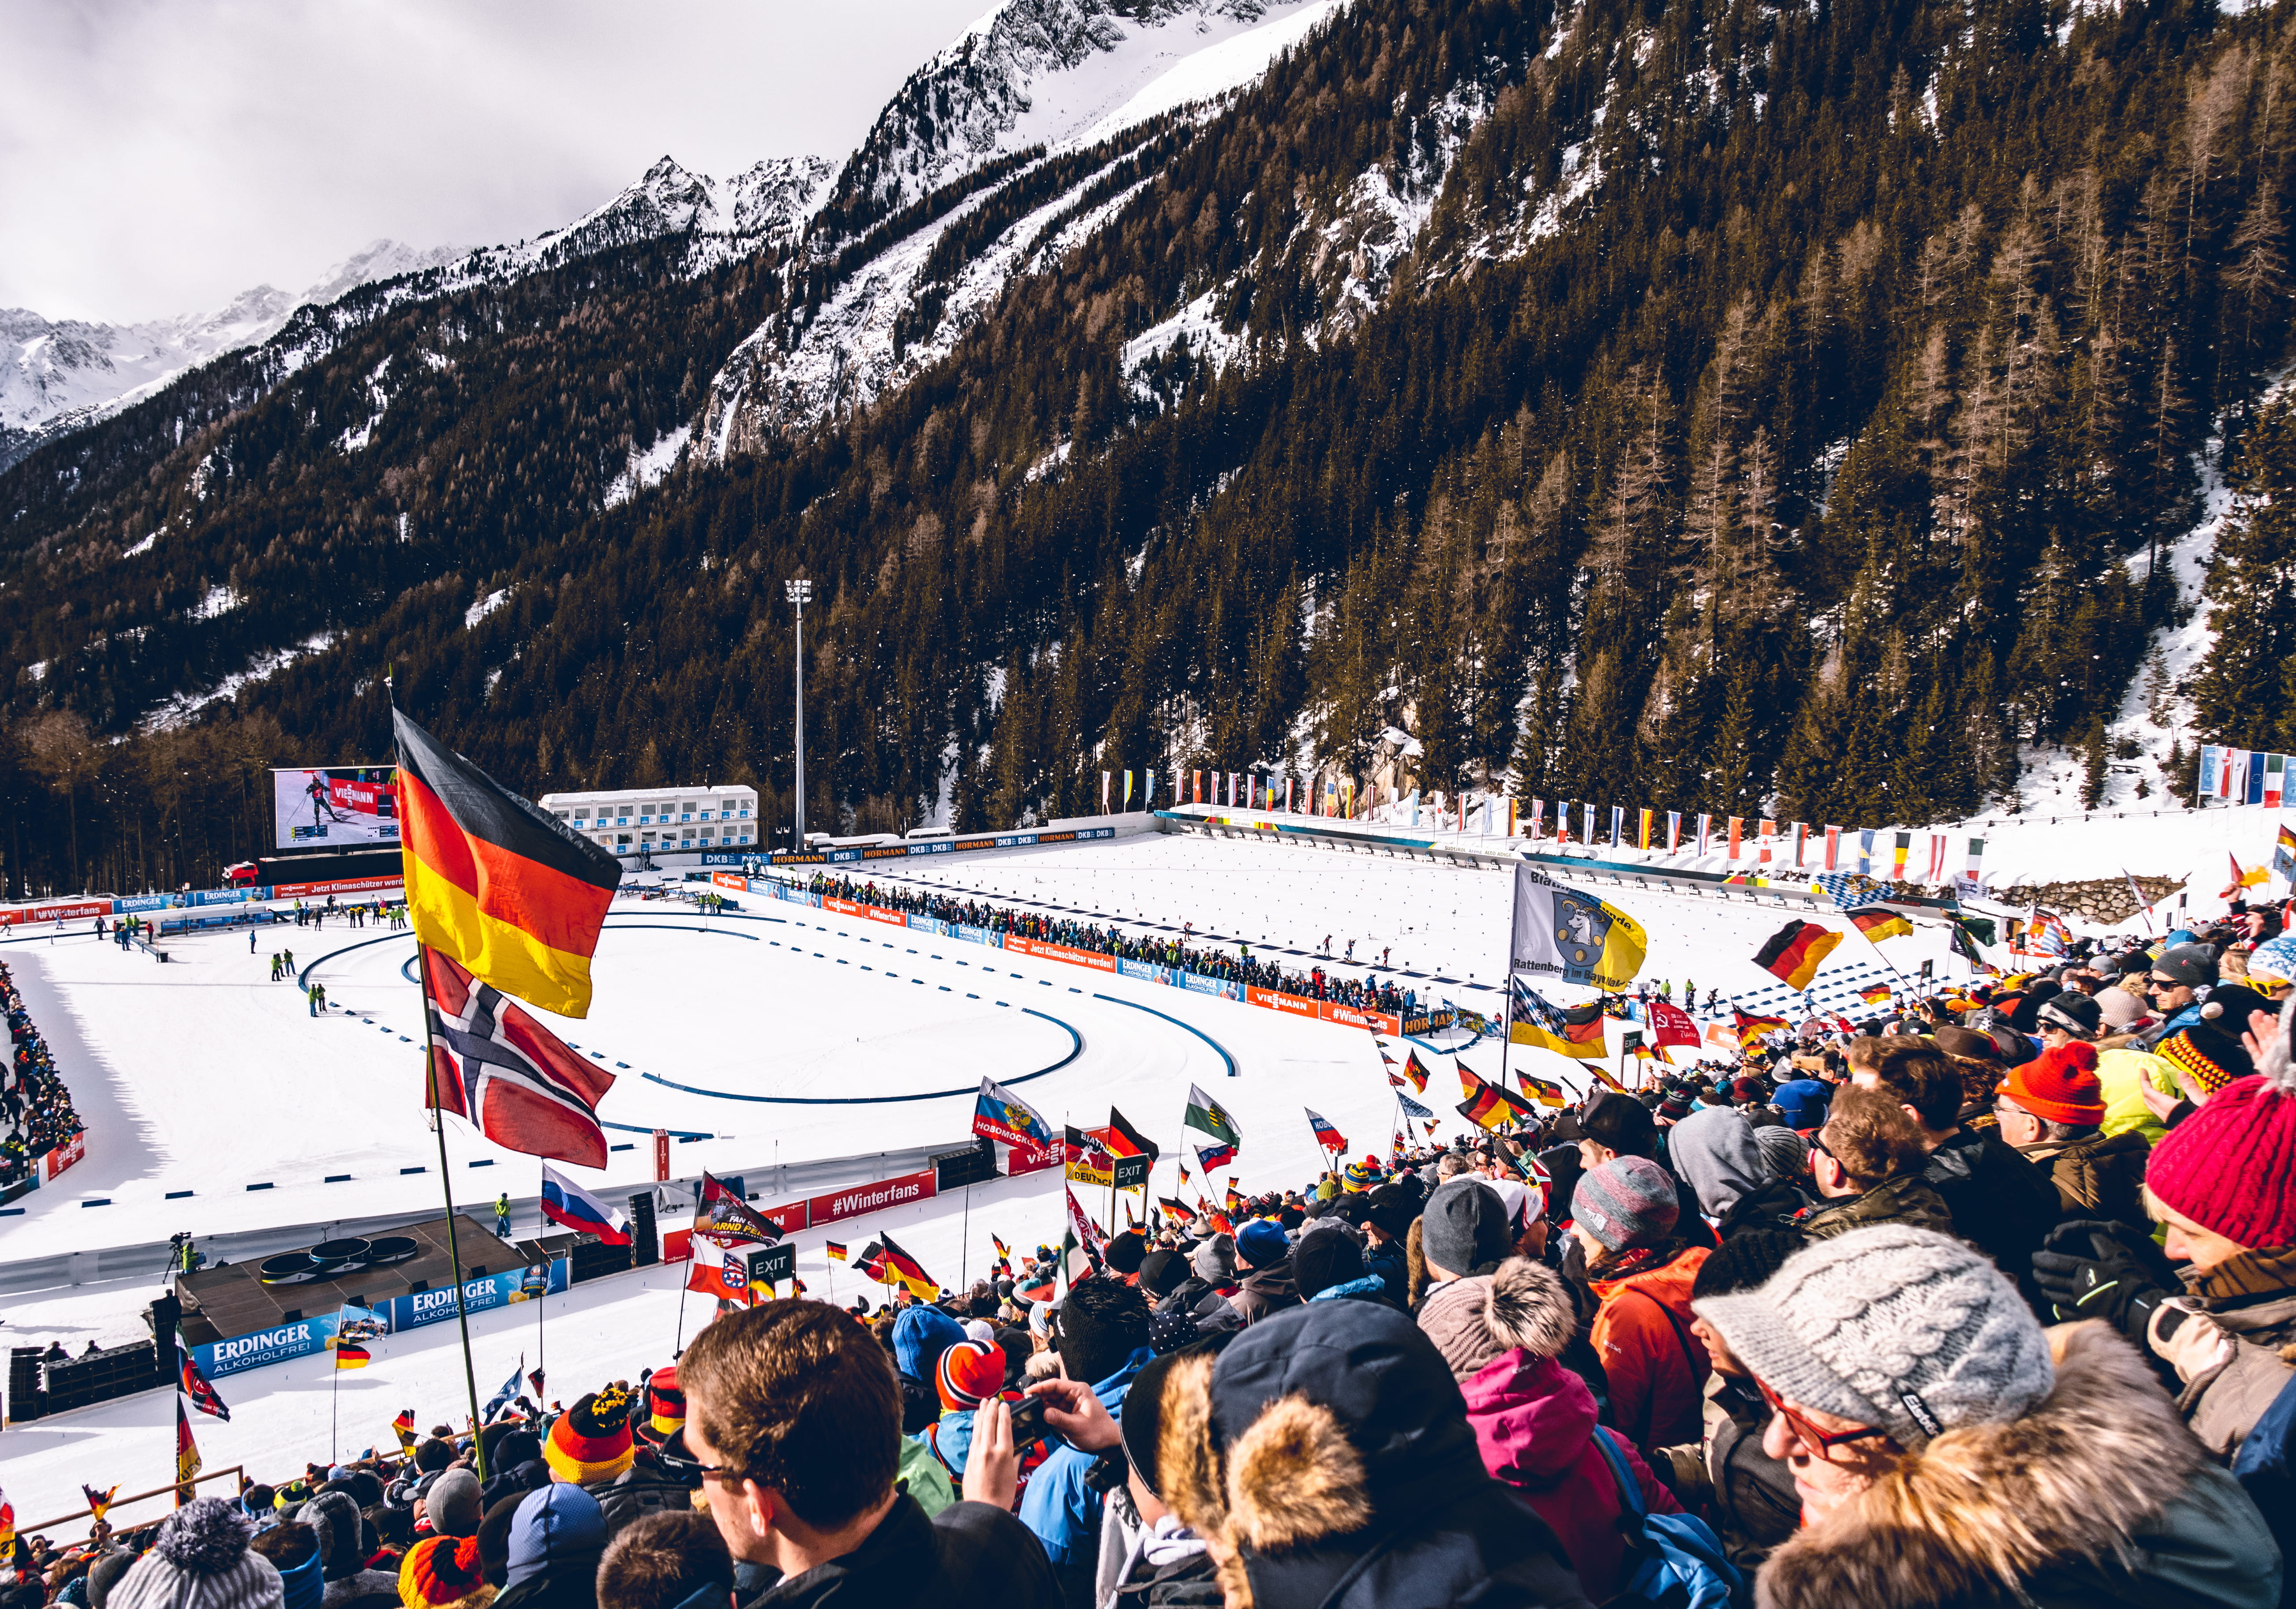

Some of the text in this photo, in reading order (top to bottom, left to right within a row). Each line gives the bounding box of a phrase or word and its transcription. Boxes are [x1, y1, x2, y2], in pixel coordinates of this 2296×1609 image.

[335, 784, 373, 806] VIESSMANN
[911, 846, 925, 854] DKB
[933, 843, 947, 852] DKB
[956, 840, 994, 849] HÖRMANN
[835, 852, 850, 861] DKB
[864, 848, 906, 858] HÖRMANN
[707, 855, 728, 863] DKB
[773, 855, 825, 864] HÖRMANN
[332, 880, 382, 891] Klimaschützer
[717, 876, 741, 887] VIESSMANN
[751, 881, 768, 891] ERDINGER
[204, 891, 241, 900] ERDINGER
[787, 890, 806, 899] ERDINGER
[122, 898, 161, 907] ERDINGER
[828, 900, 856, 912] VIESSMANN
[870, 909, 900, 923] #Winterfans
[911, 915, 933, 927] ERDINGER
[959, 925, 982, 938] ERDINGER
[1030, 943, 1113, 969] Jetzt Klimaschützer werden!
[1123, 959, 1152, 975] ERDINGER
[1513, 958, 1568, 978] Rattenberg
[1572, 968, 1582, 978] im
[1123, 969, 1151, 979] ALKOHOLFREI
[1185, 973, 1217, 989] ERDINGER
[1185, 983, 1217, 993] ALKOHOLFREI
[1256, 993, 1307, 1010] VIESSMANN
[1624, 1038, 1638, 1048] EXIT
[1118, 1165, 1142, 1179] EXIT
[833, 1183, 919, 1216] #Winterfans
[729, 1215, 746, 1224] FAN
[712, 1222, 742, 1231] ARND
[756, 1256, 786, 1275] EXIT
[213, 1324, 312, 1362] ERDINGER
[214, 1342, 310, 1373] ALKOHOLFREI
